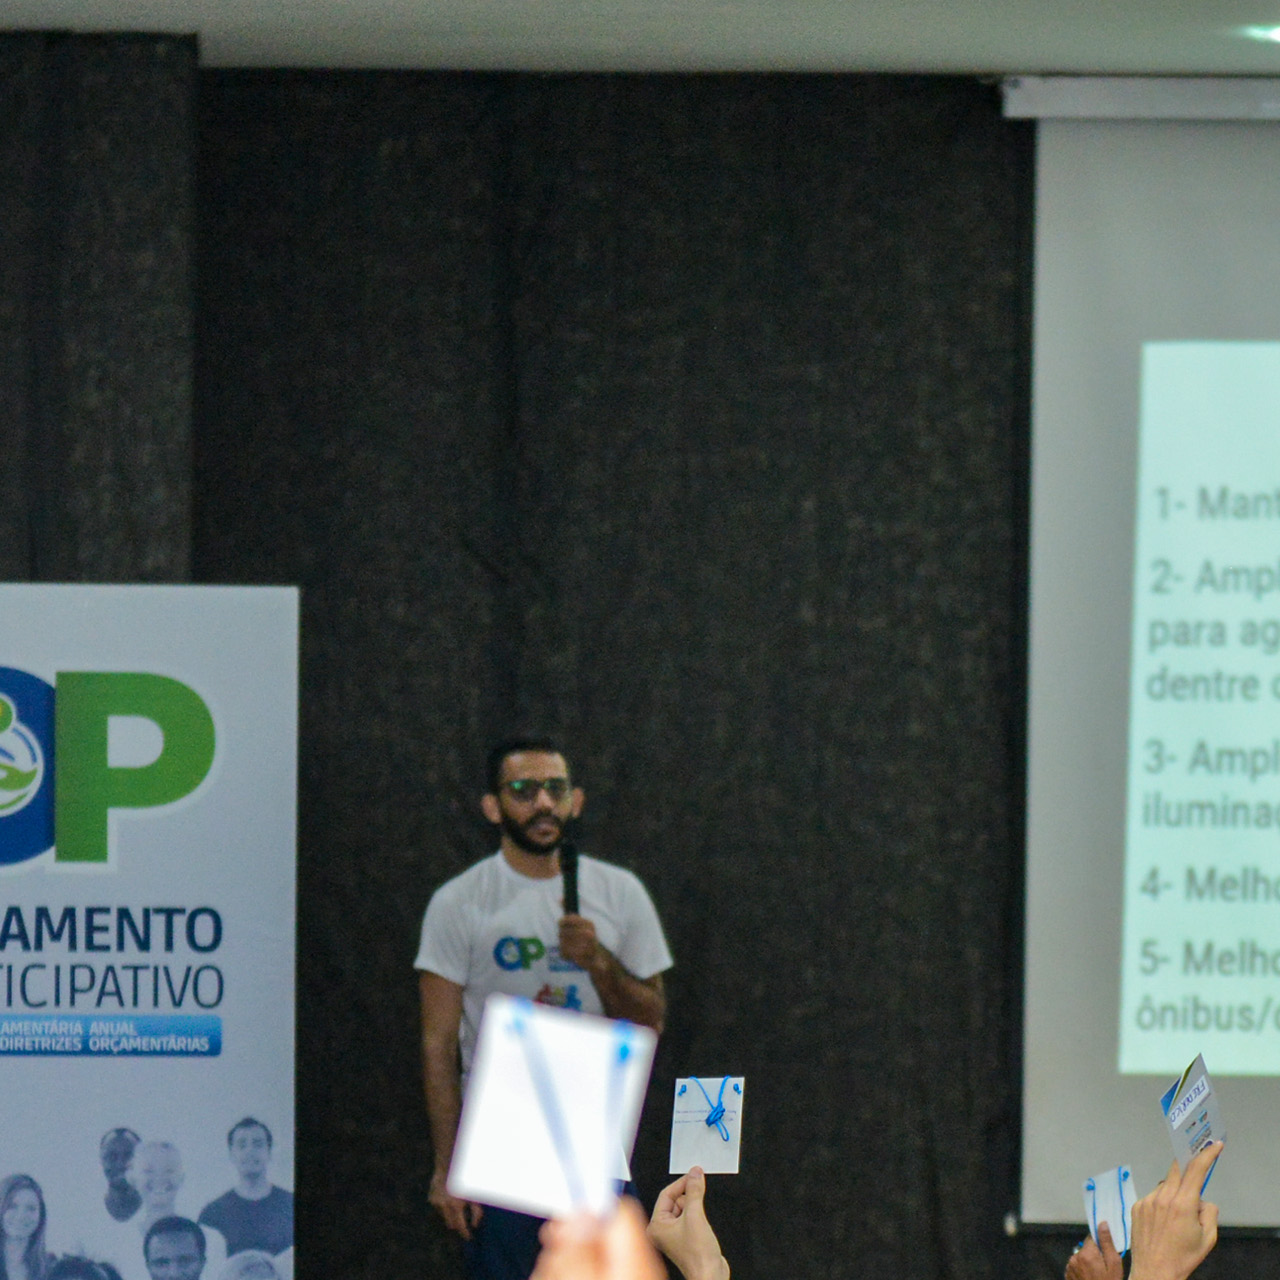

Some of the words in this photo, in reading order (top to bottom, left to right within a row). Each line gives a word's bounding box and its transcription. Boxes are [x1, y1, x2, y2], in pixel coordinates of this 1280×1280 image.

[1156, 486, 1186, 520] 1-
[1148, 619, 1227, 654] 2-
[1148, 666, 1260, 703] para
[1144, 739, 1176, 776] dentre
[1140, 867, 1173, 902] iluminação);
[1139, 939, 1171, 976] 4-
[0, 1037, 82, 1052] DIRETRIZES
[89, 1034, 209, 1054] ORÇAMENTÁRIAS
[89, 1021, 138, 1036] ANUAL
